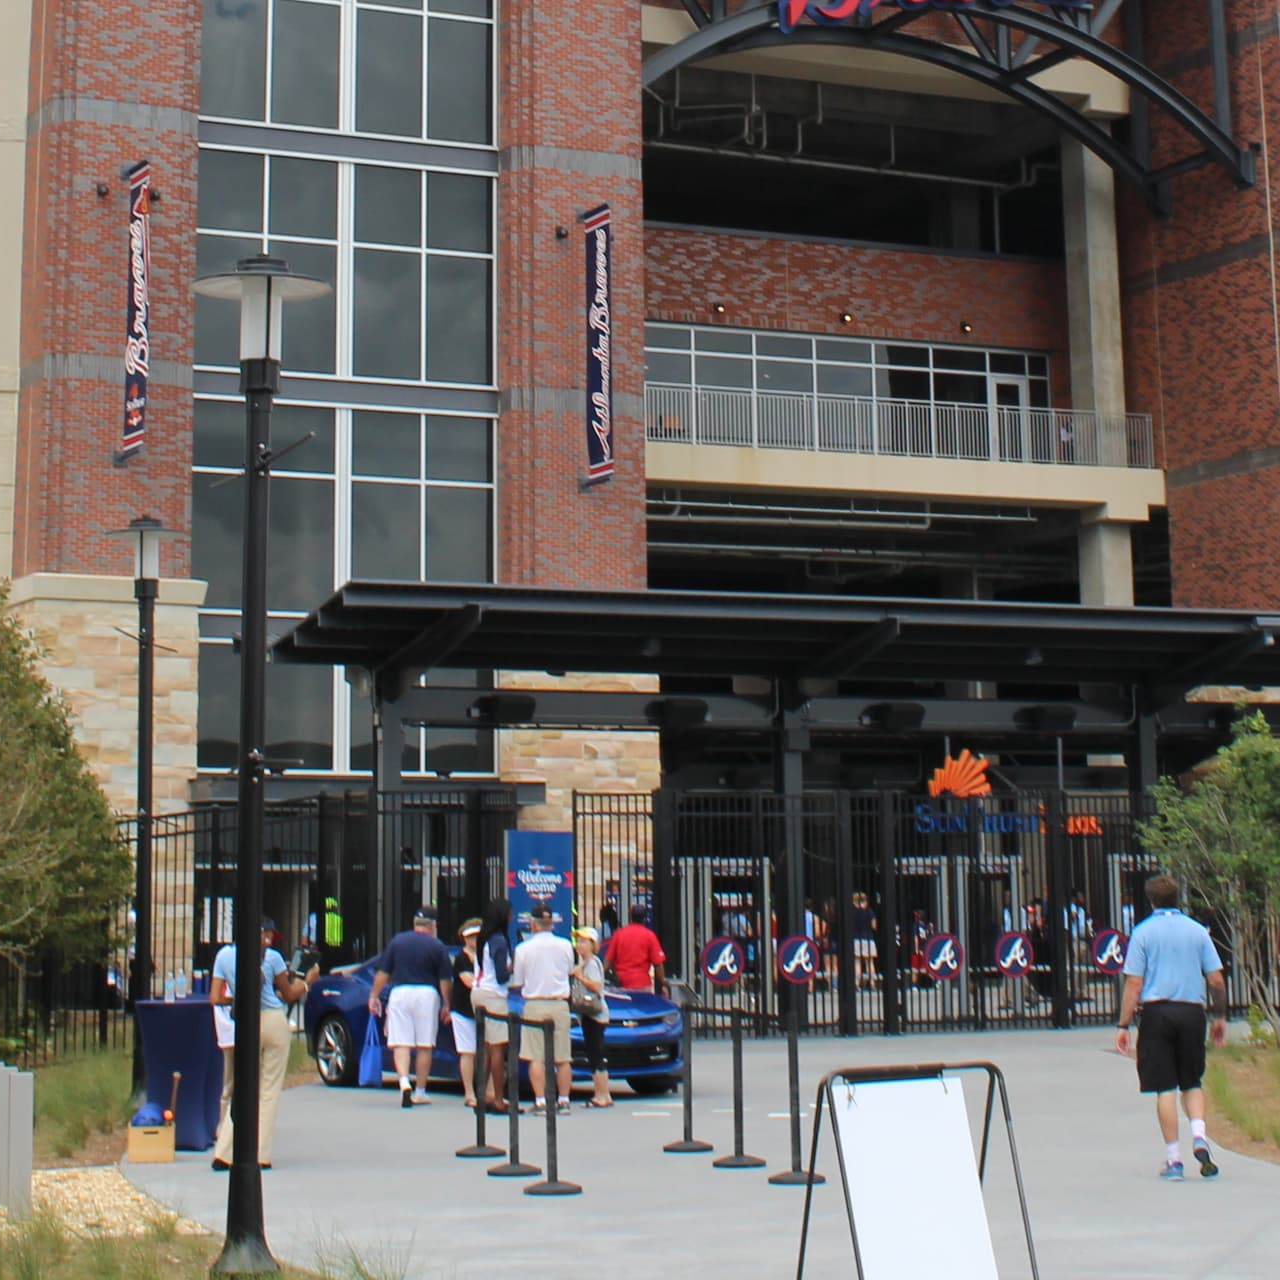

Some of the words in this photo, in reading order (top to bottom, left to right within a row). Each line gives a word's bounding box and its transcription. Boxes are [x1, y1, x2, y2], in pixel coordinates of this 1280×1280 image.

[125, 219, 149, 377] Braves
[588, 228, 611, 335] Braves
[591, 333, 611, 462] Atlanta
[517, 869, 562, 884] Welcome
